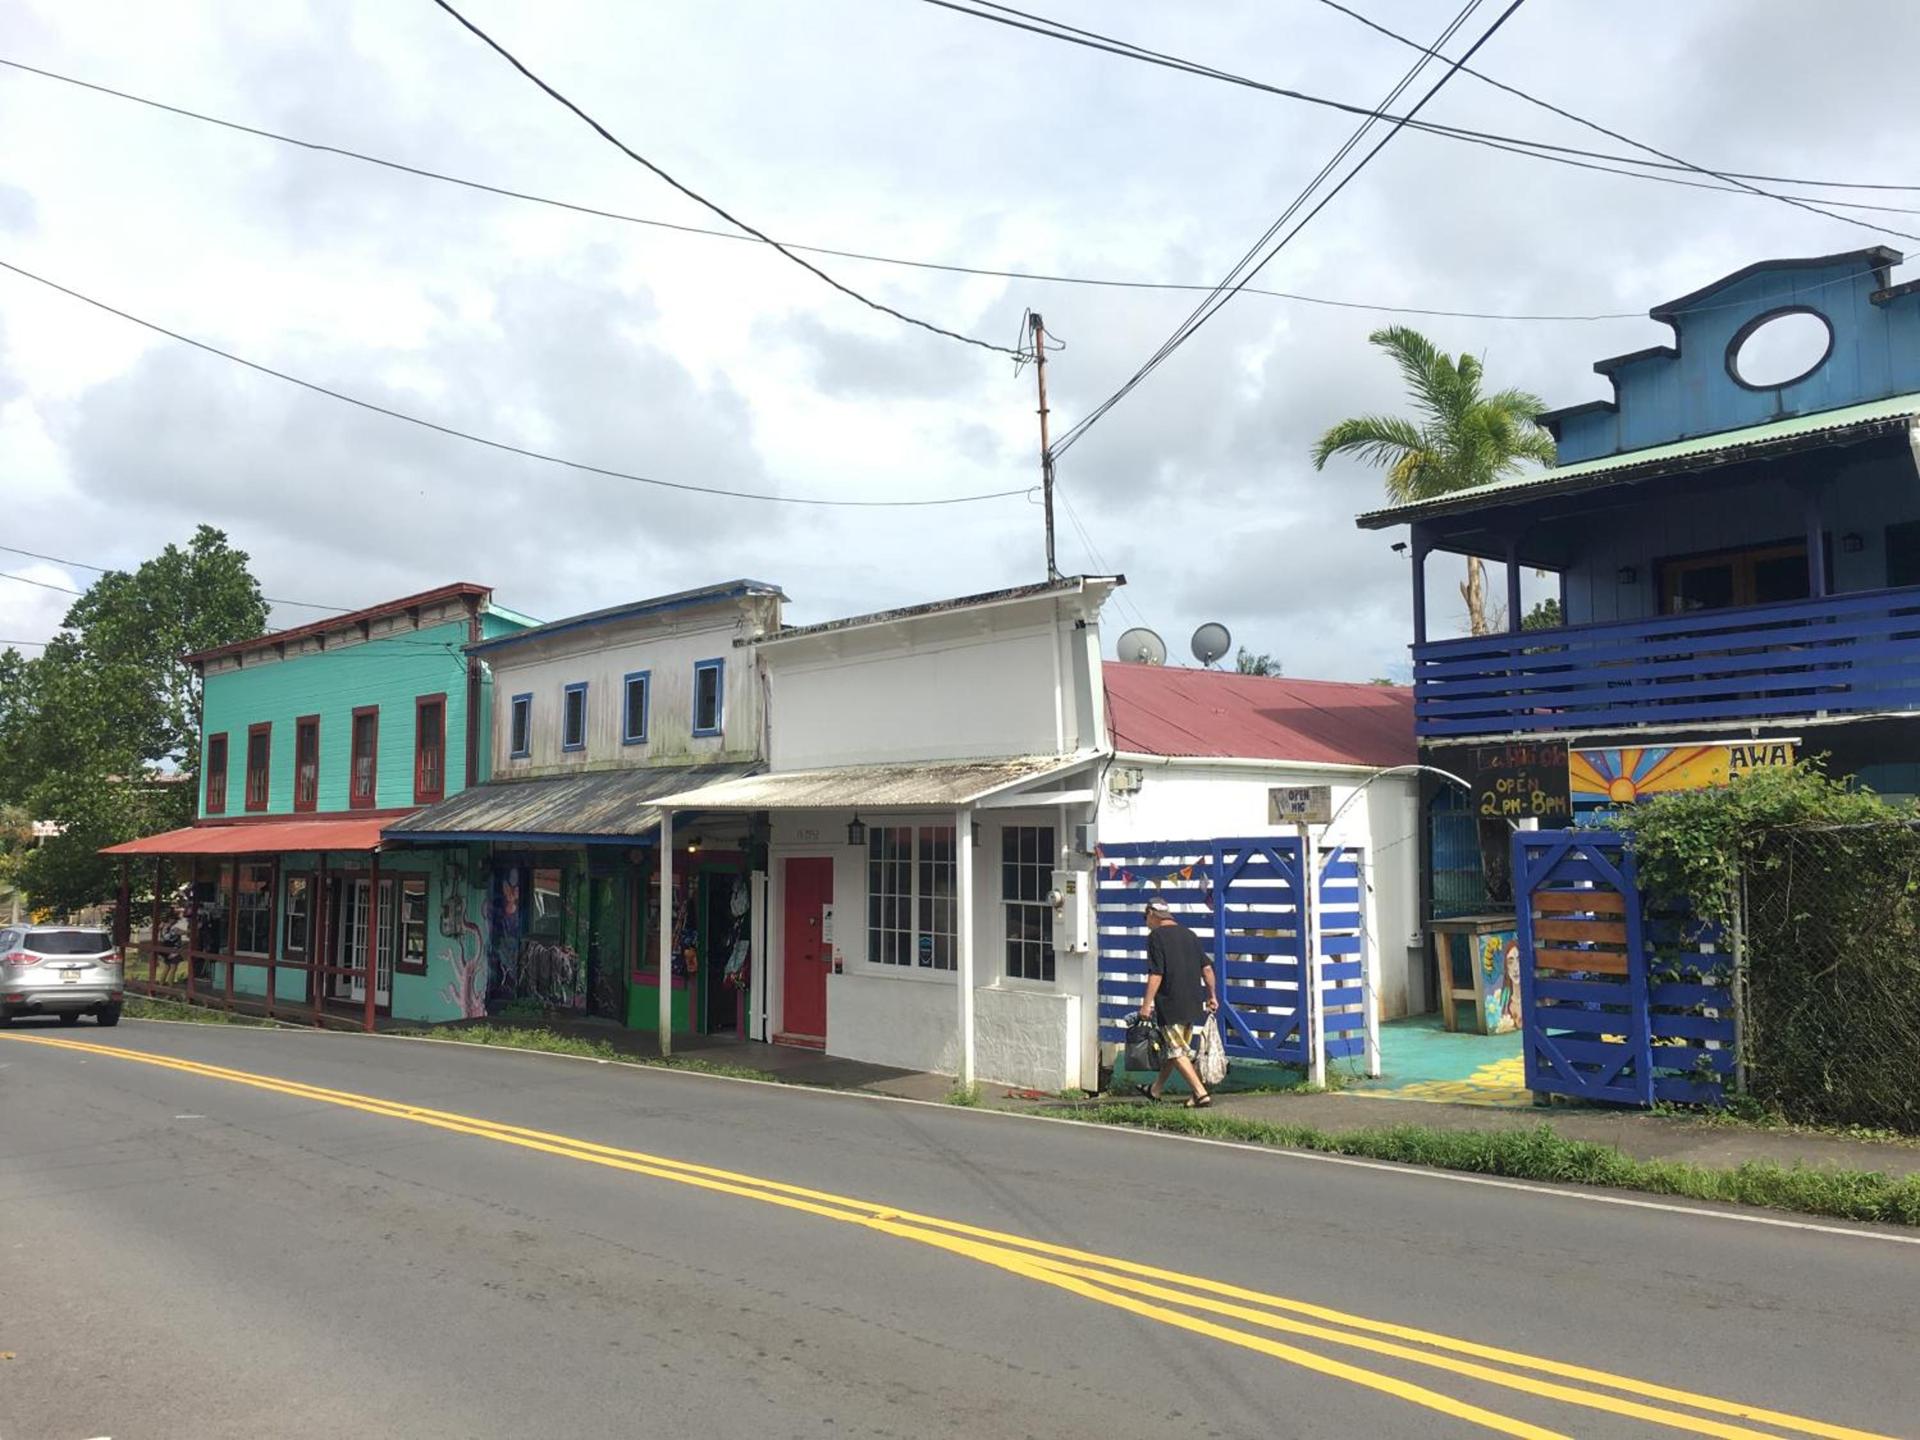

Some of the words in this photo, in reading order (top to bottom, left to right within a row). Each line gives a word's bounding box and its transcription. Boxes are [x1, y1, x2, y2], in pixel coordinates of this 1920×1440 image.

[1730, 744, 1788, 768] AWA
[1496, 778, 1539, 794] OPEN
[1288, 789, 1310, 801] OPEN
